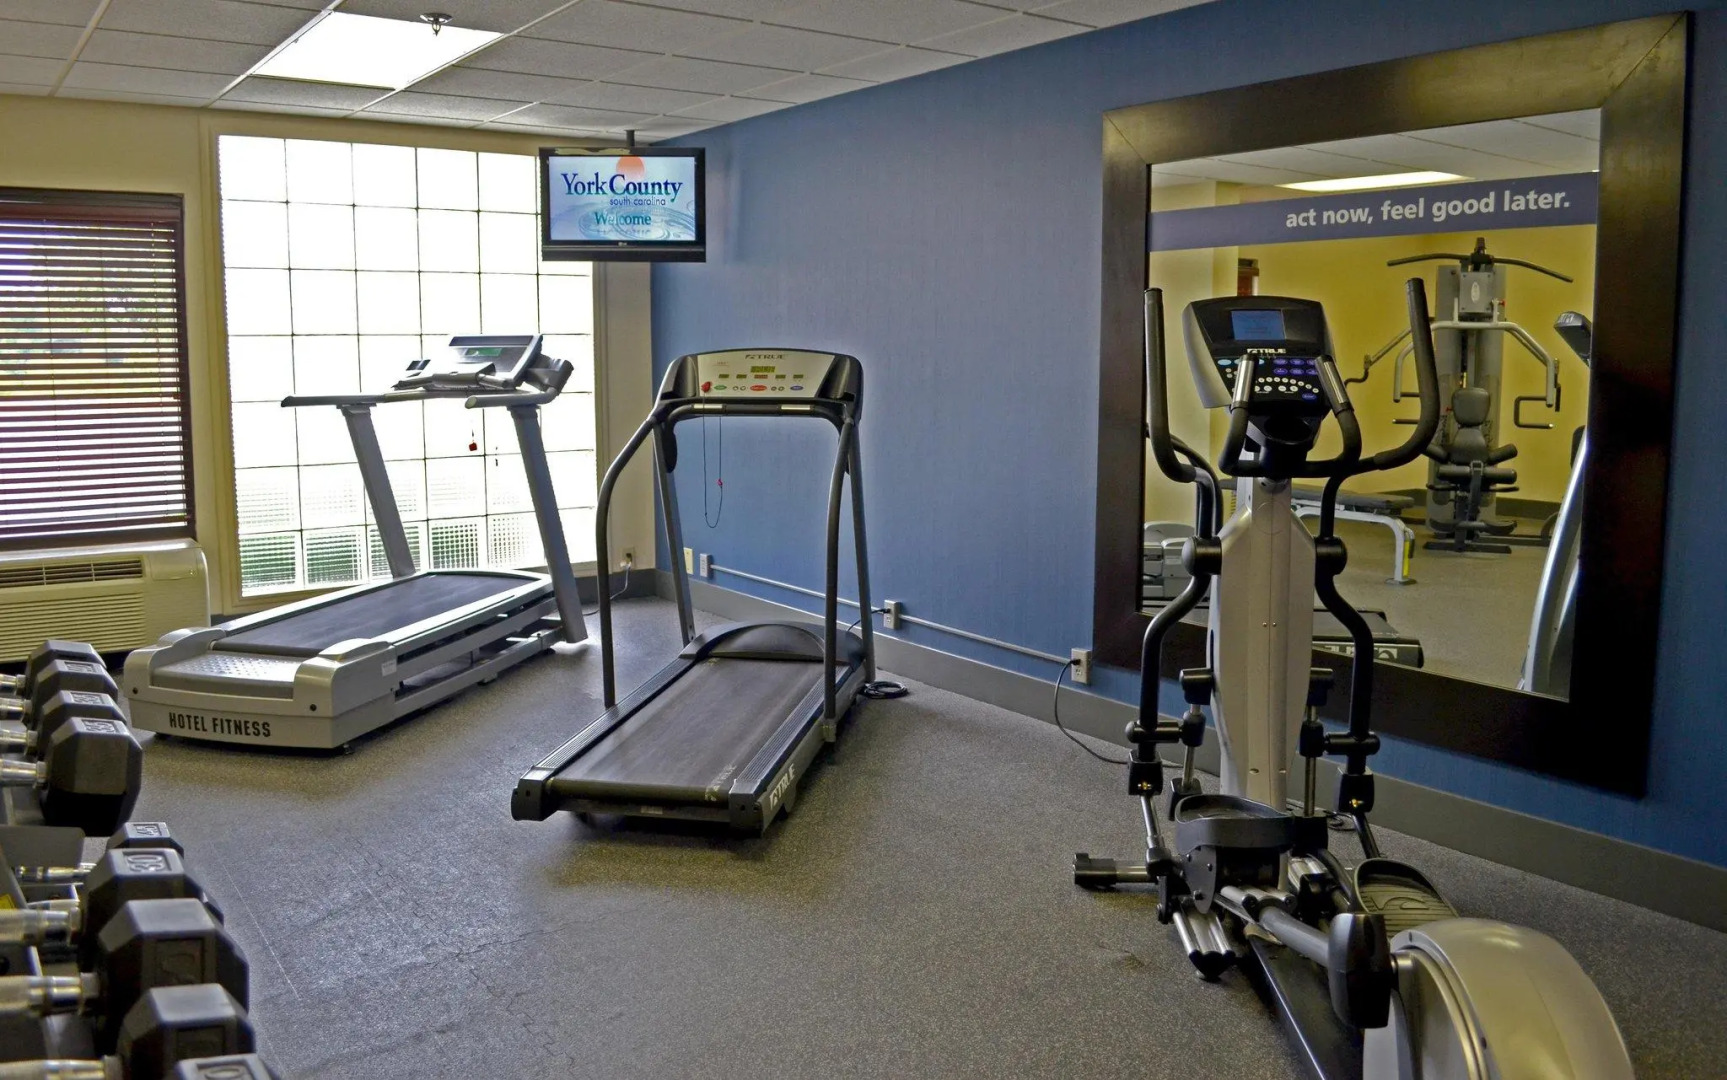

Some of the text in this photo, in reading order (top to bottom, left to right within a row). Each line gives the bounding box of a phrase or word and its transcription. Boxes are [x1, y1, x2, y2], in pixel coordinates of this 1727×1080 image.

[561, 172, 683, 203] York County
[610, 196, 666, 206] south carolina
[1285, 188, 1570, 228] act now, feel good later.
[594, 211, 652, 226] Welcome
[168, 712, 272, 738] HOTEL FITNESS
